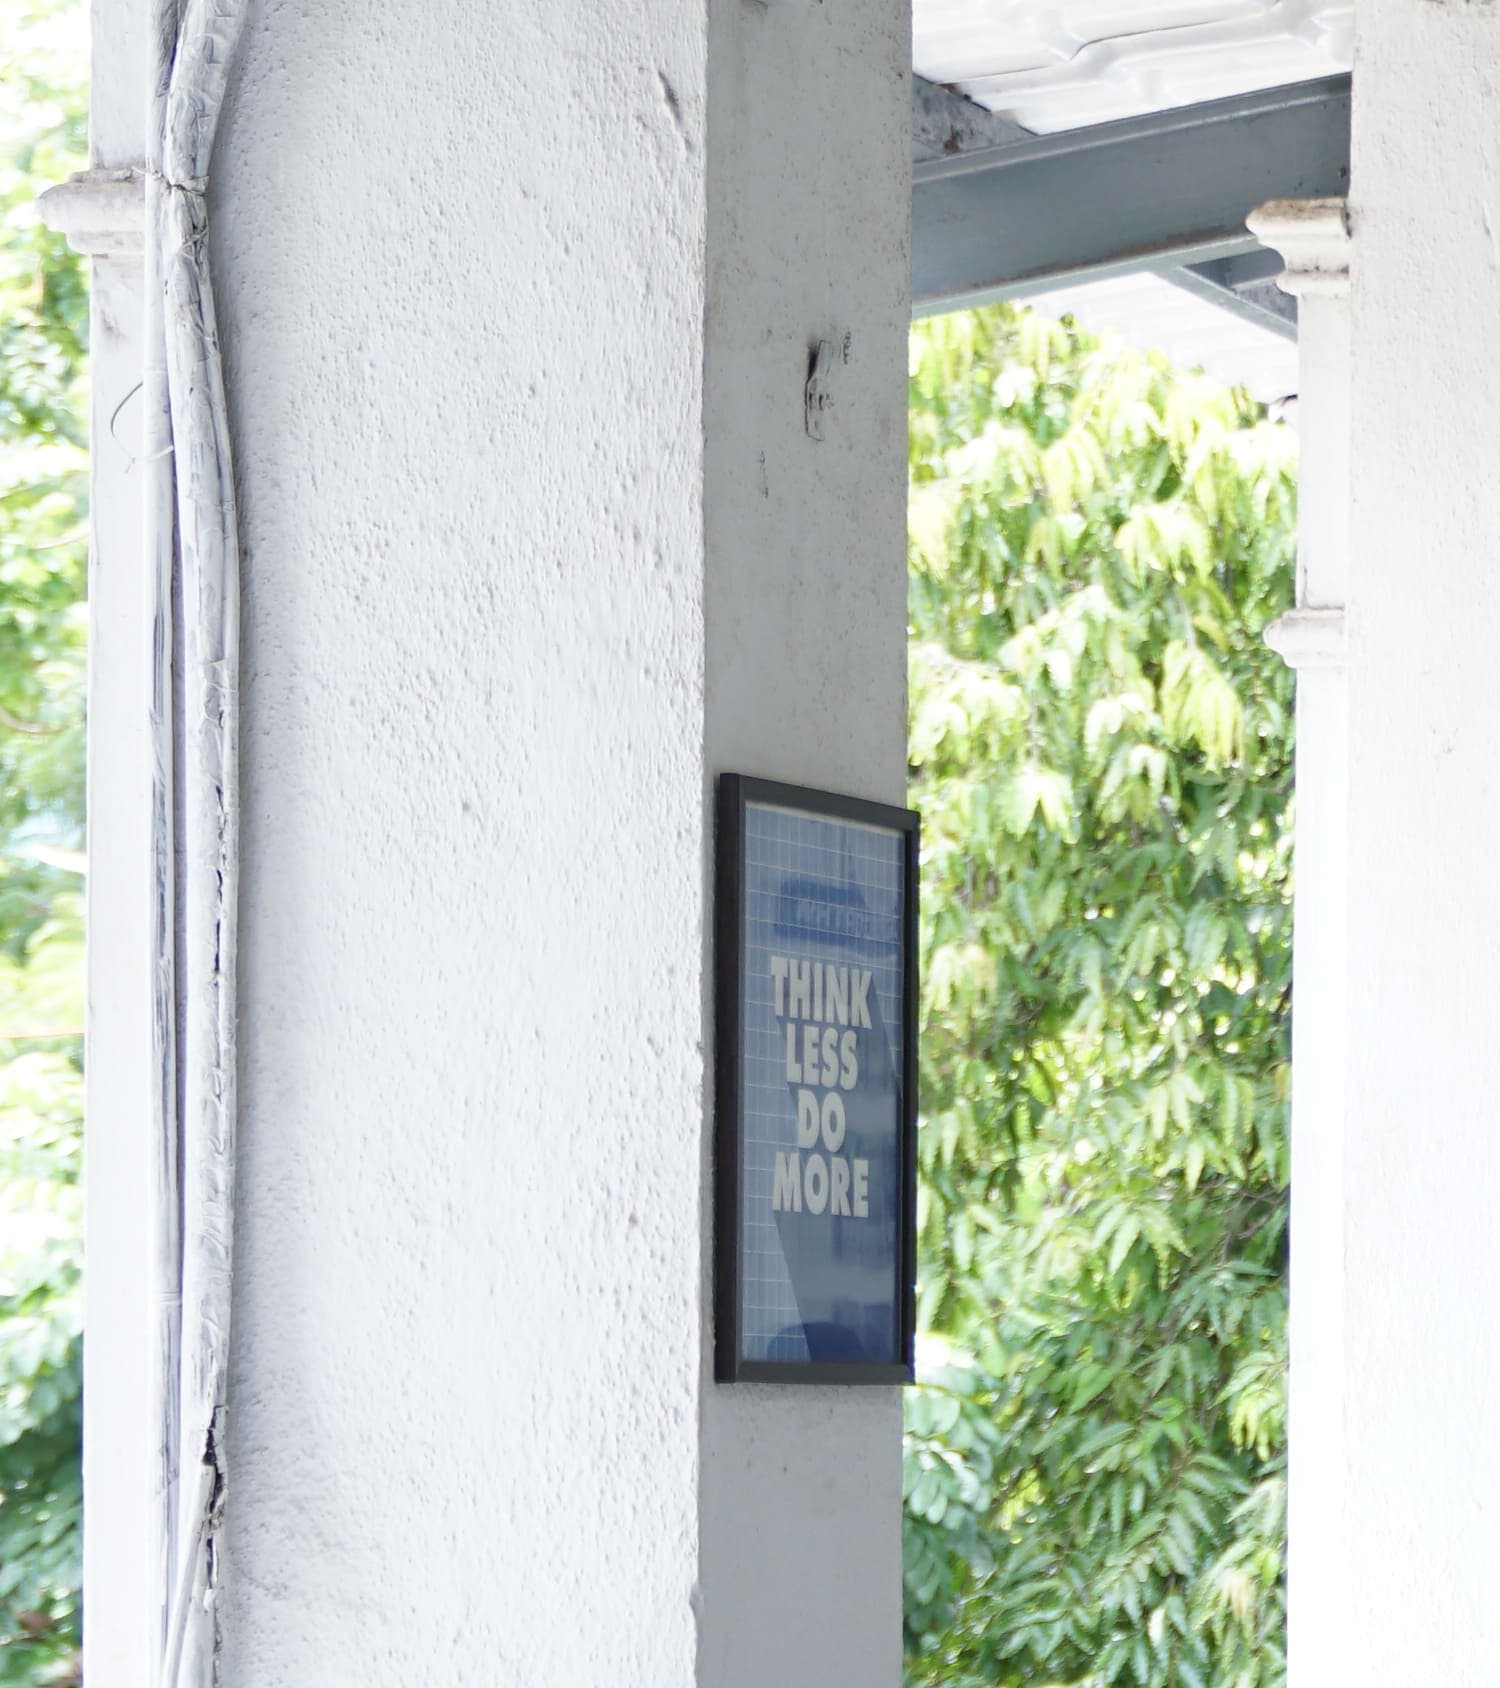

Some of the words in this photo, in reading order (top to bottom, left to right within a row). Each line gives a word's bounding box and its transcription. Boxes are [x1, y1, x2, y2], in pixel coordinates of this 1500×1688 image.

[770, 955, 873, 1029] THINK
[786, 1022, 858, 1090] LESS
[798, 1089, 846, 1153] DO
[772, 1151, 869, 1218] MORE
